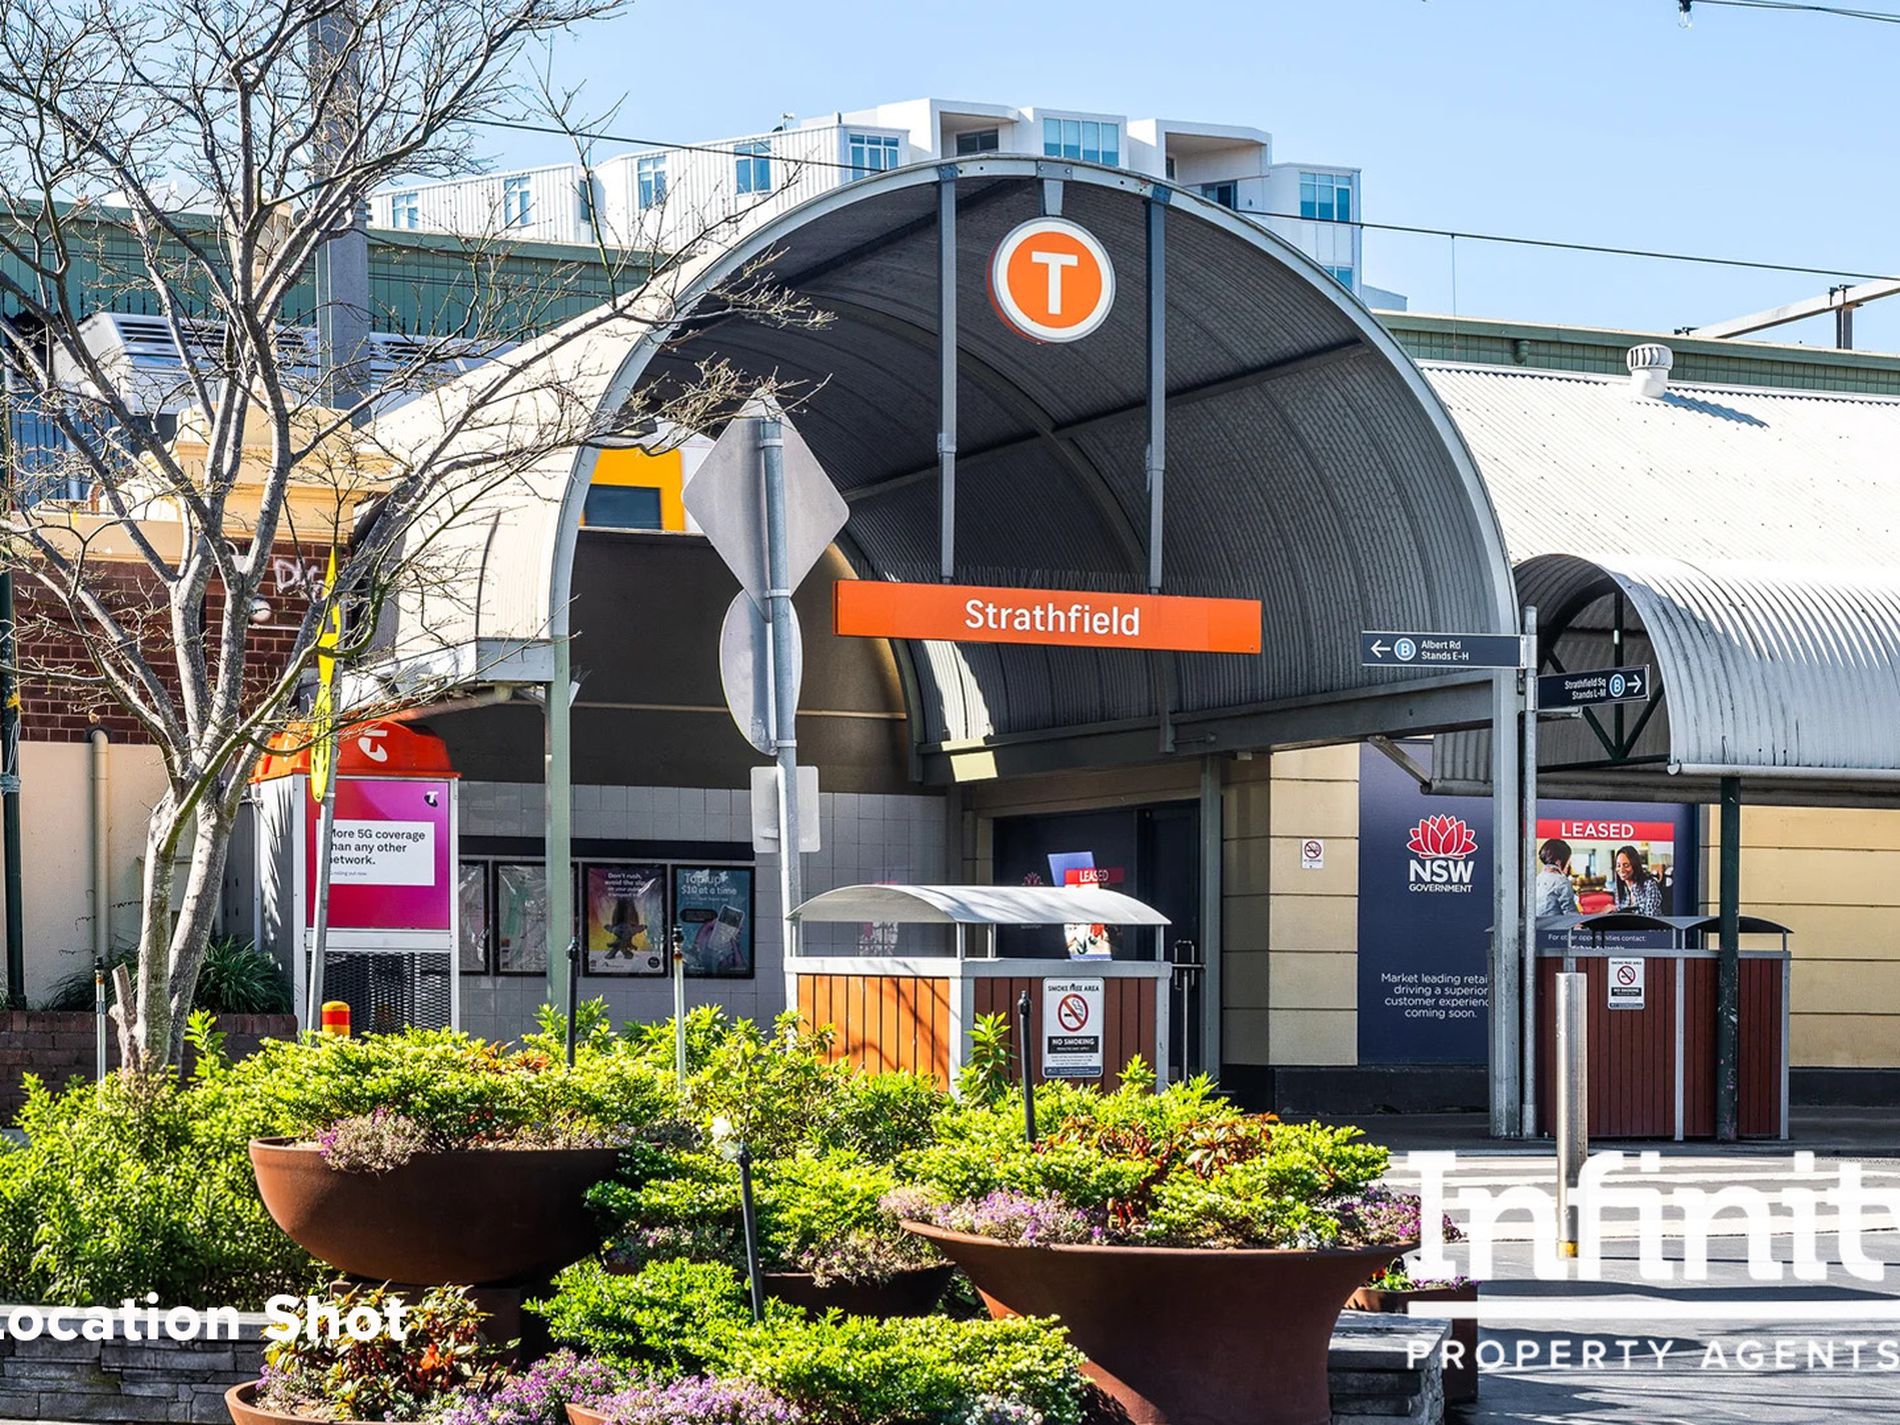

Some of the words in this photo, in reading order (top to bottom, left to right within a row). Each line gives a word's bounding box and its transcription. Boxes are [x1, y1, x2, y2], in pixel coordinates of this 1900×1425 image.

[1030, 249, 1079, 316] T
[964, 598, 1141, 637] Strathfield
[1421, 640, 1448, 650] Albert
[1449, 640, 1462, 650] Rd
[1421, 650, 1452, 660] Stands
[1452, 651, 1470, 661] E-H
[1564, 677, 1597, 690] Strathfield
[1597, 677, 1607, 688] Sq
[1572, 689, 1594, 701] Stands
[357, 828, 373, 839] 5G
[375, 831, 426, 843] coverage
[1561, 822, 1635, 839] LEASED
[330, 841, 352, 852] han
[354, 843, 375, 854] any
[377, 843, 407, 853] other
[1079, 869, 1109, 882] LEASED
[1409, 859, 1475, 883] NSW
[681, 884, 698, 895] $10
[698, 887, 709, 895] at
[716, 887, 738, 896] time
[1408, 883, 1473, 893] GOVERNMENT
[1548, 933, 1560, 941] For
[1381, 973, 1419, 983] Market
[1421, 973, 1461, 985] leading
[1463, 974, 1488, 984] retai
[1393, 985, 1432, 997] driving
[1444, 986, 1488, 996] superior
[1384, 997, 1436, 1006] customer
[1438, 997, 1489, 1007] experienc
[1404, 1008, 1446, 1020] coming
[1448, 1009, 1478, 1019] soon.
[1051, 1038, 1063, 1046] NO
[1064, 1038, 1095, 1046] SMOKING
